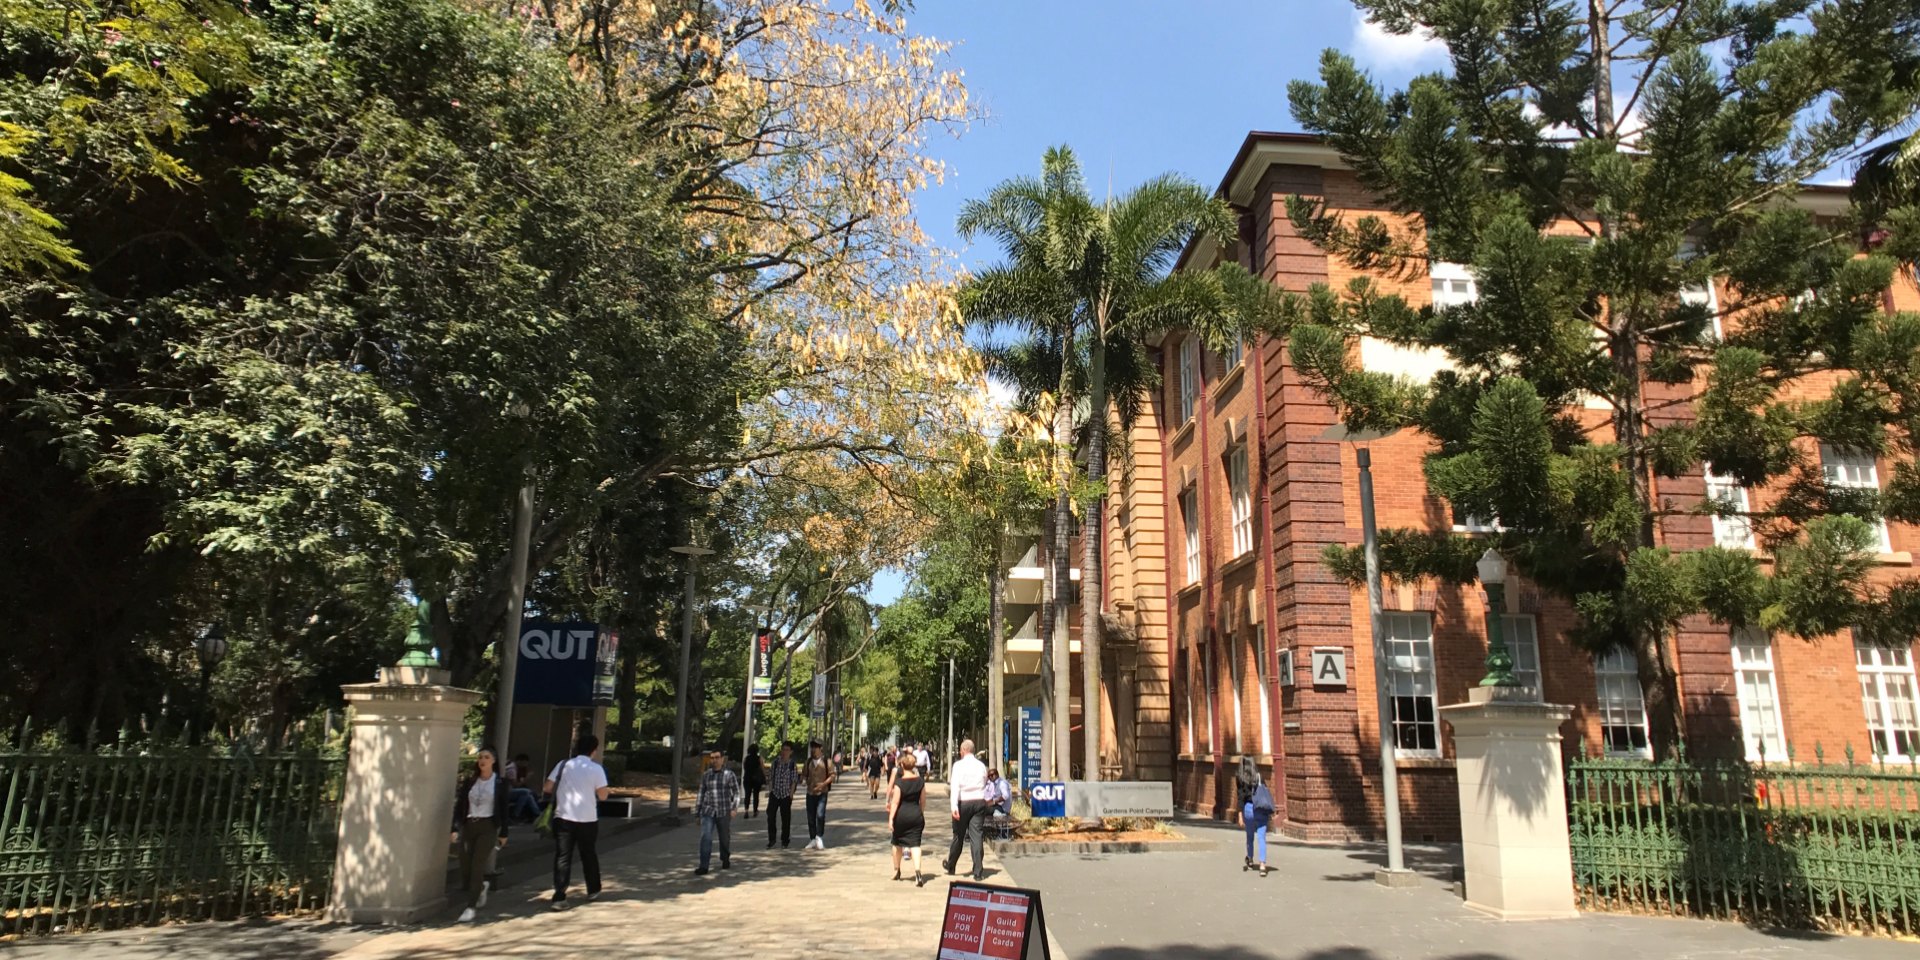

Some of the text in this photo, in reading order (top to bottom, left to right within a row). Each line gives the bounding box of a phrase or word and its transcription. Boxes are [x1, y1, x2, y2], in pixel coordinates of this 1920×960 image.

[520, 629, 594, 660] QUT
[759, 653, 769, 677] burger
[1281, 656, 1290, 682] A
[1319, 655, 1341, 680] A
[1032, 785, 1065, 801] QUT
[1103, 807, 1169, 816] Gardens Point Campus
[953, 912, 976, 923] FIGHT
[996, 917, 1017, 927] Guild
[955, 923, 971, 932] FOR
[944, 931, 979, 943] SWOTVAC
[992, 937, 1014, 947] Cards
